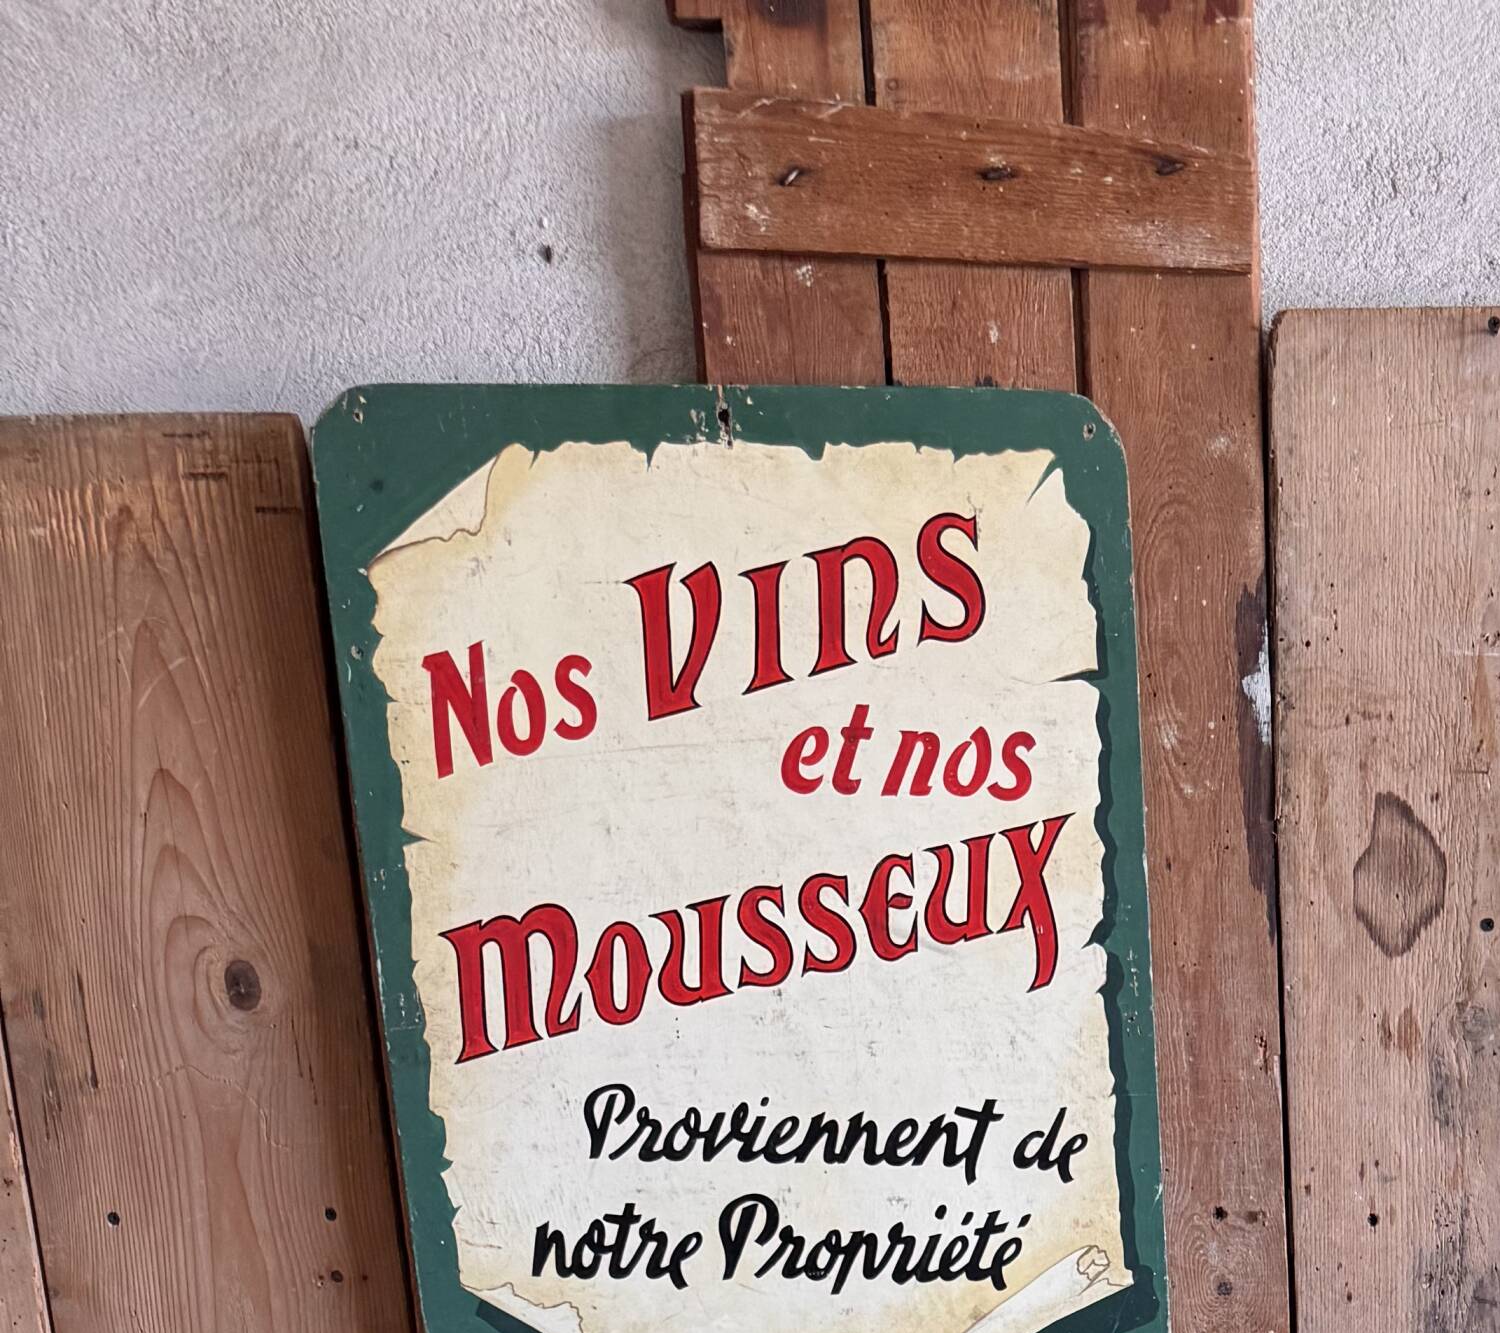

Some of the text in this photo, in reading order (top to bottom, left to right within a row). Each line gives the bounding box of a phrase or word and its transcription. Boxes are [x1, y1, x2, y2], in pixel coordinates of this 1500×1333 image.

[421, 511, 987, 779] Nos VINS
[780, 703, 1037, 800] et nos
[439, 812, 1076, 1065] MOUSSEUX
[583, 1082, 1088, 1184] Proviennent de
[532, 1193, 1030, 1295] notre Propriété
